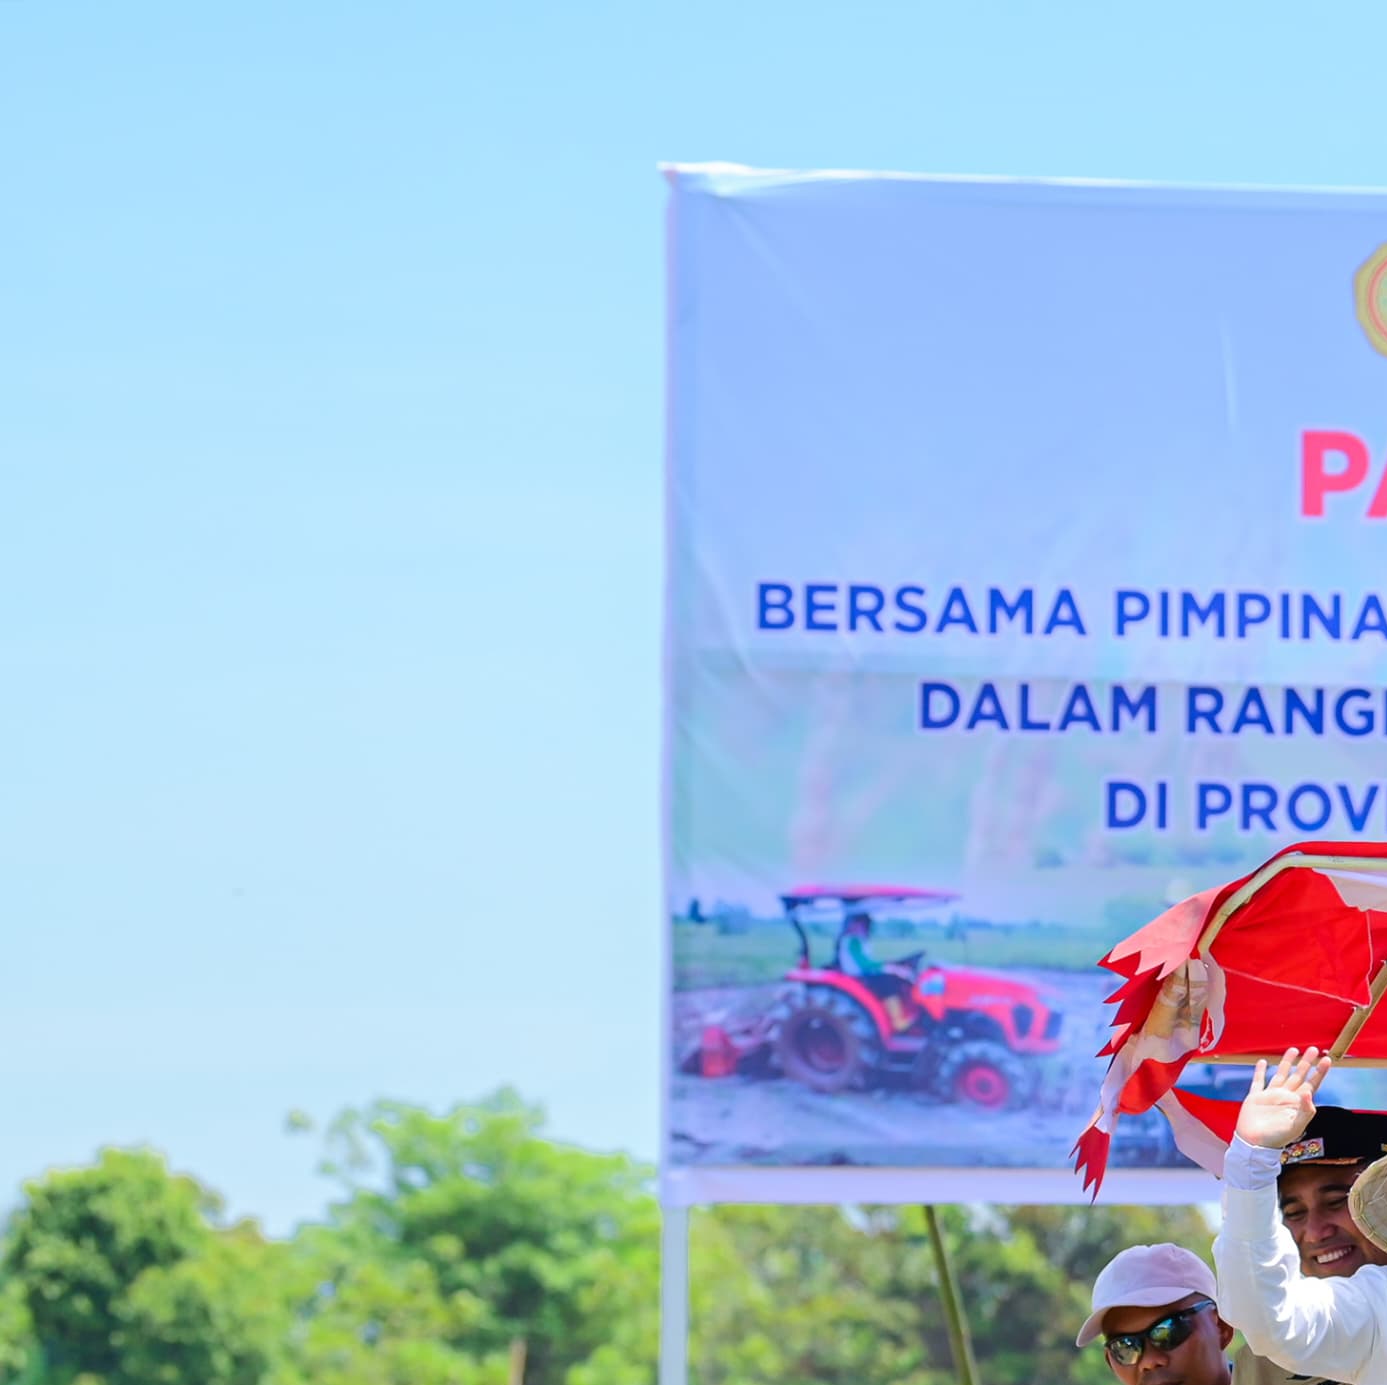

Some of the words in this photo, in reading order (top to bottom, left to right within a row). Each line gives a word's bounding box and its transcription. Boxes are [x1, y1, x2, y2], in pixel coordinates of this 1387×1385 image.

[757, 582, 1087, 636] BERSAMA
[920, 681, 1157, 733] DALAM
[1107, 781, 1168, 830] DI
